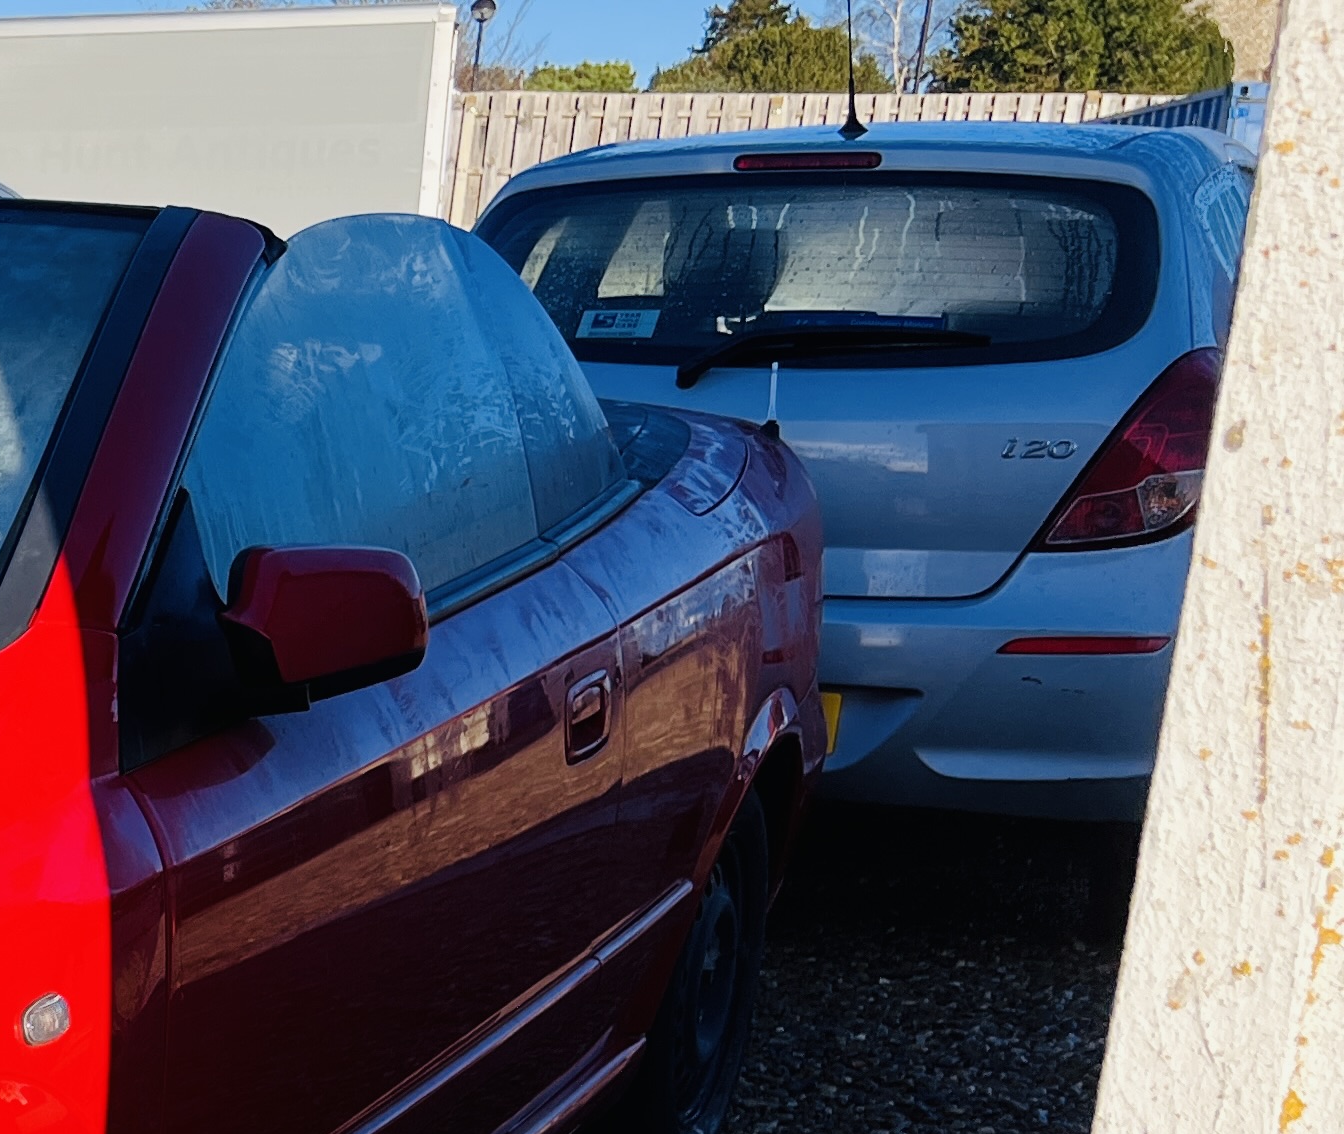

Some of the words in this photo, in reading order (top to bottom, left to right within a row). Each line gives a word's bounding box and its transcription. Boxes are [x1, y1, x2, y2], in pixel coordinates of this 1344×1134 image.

[39, 133, 152, 174] Hunt
[168, 134, 382, 177] Antiques
[1001, 437, 1078, 459] i20
